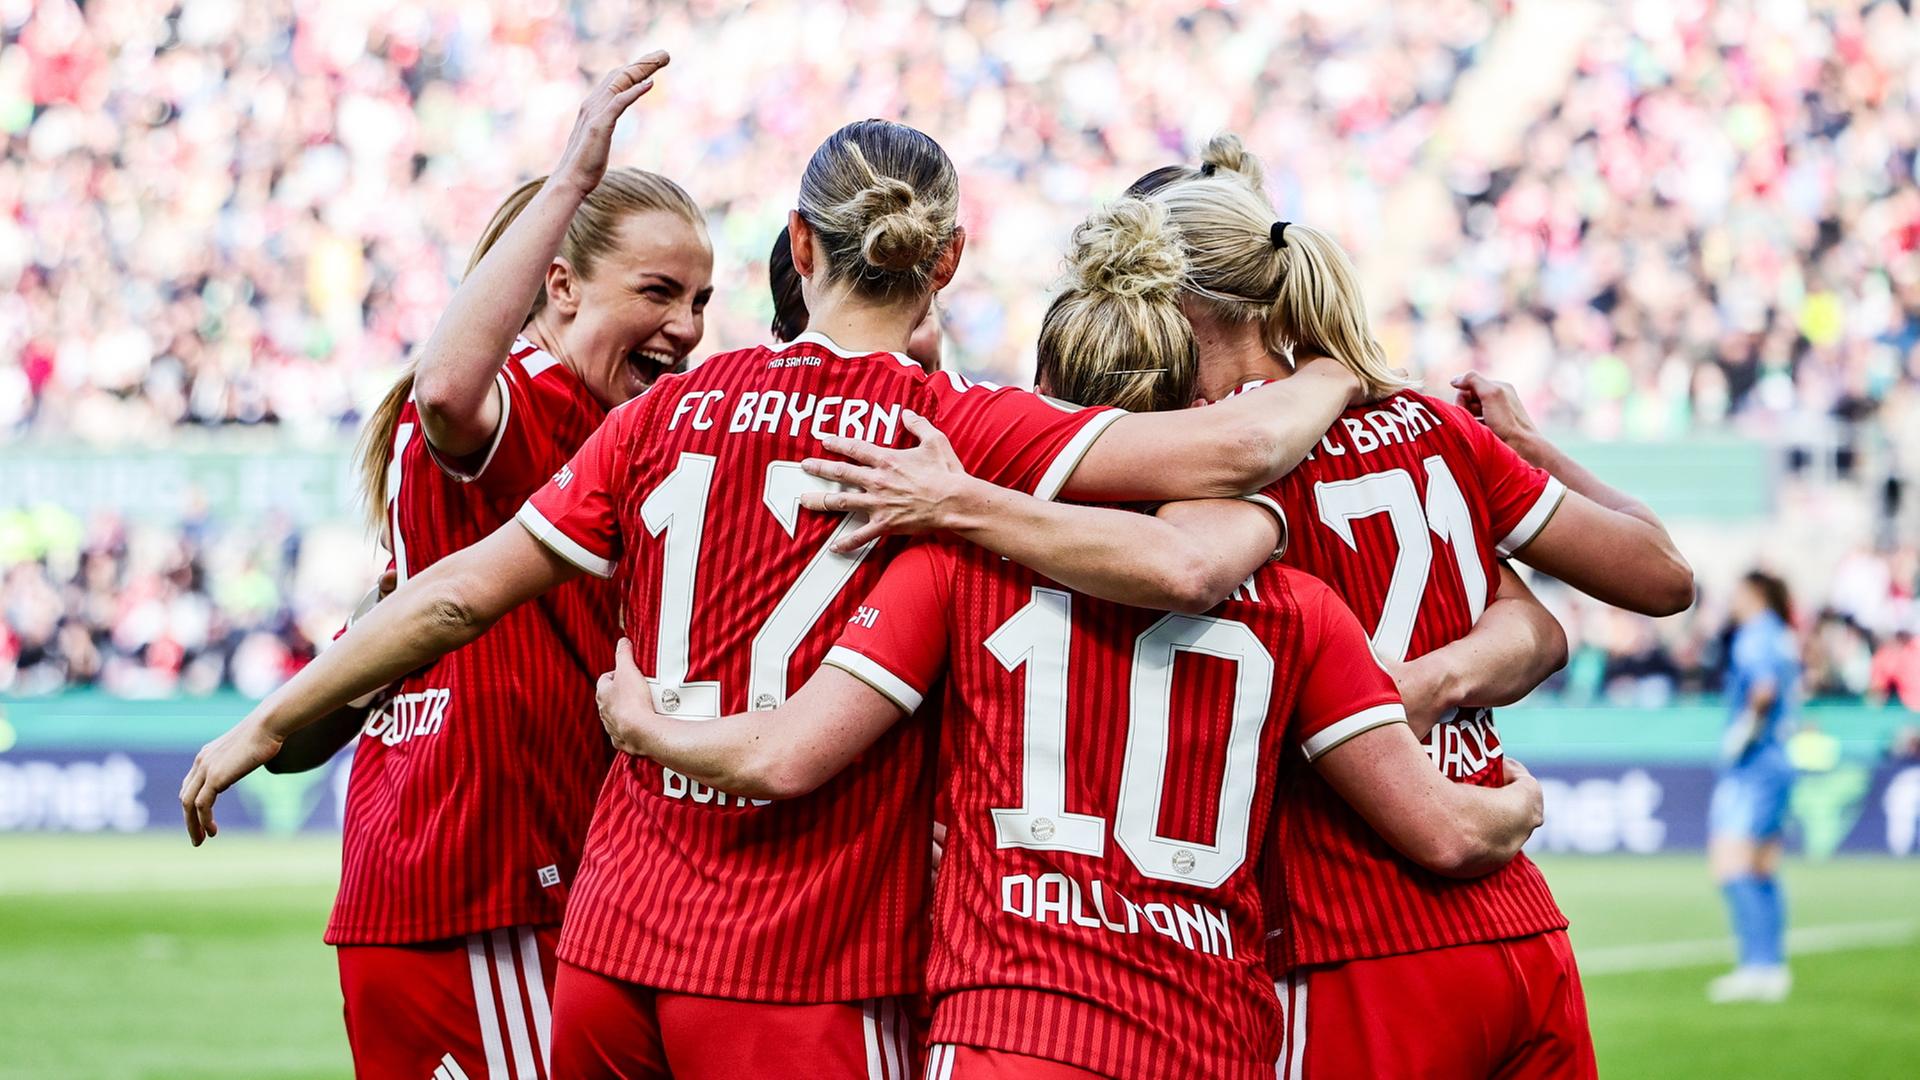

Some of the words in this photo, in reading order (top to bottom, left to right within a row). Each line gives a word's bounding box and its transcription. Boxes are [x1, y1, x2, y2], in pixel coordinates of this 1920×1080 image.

[802, 355, 821, 367] MIA
[668, 390, 725, 432] FC
[728, 390, 901, 446] BAYERN
[983, 586, 1275, 889] 10
[1001, 872, 1235, 961] DALLMANN
